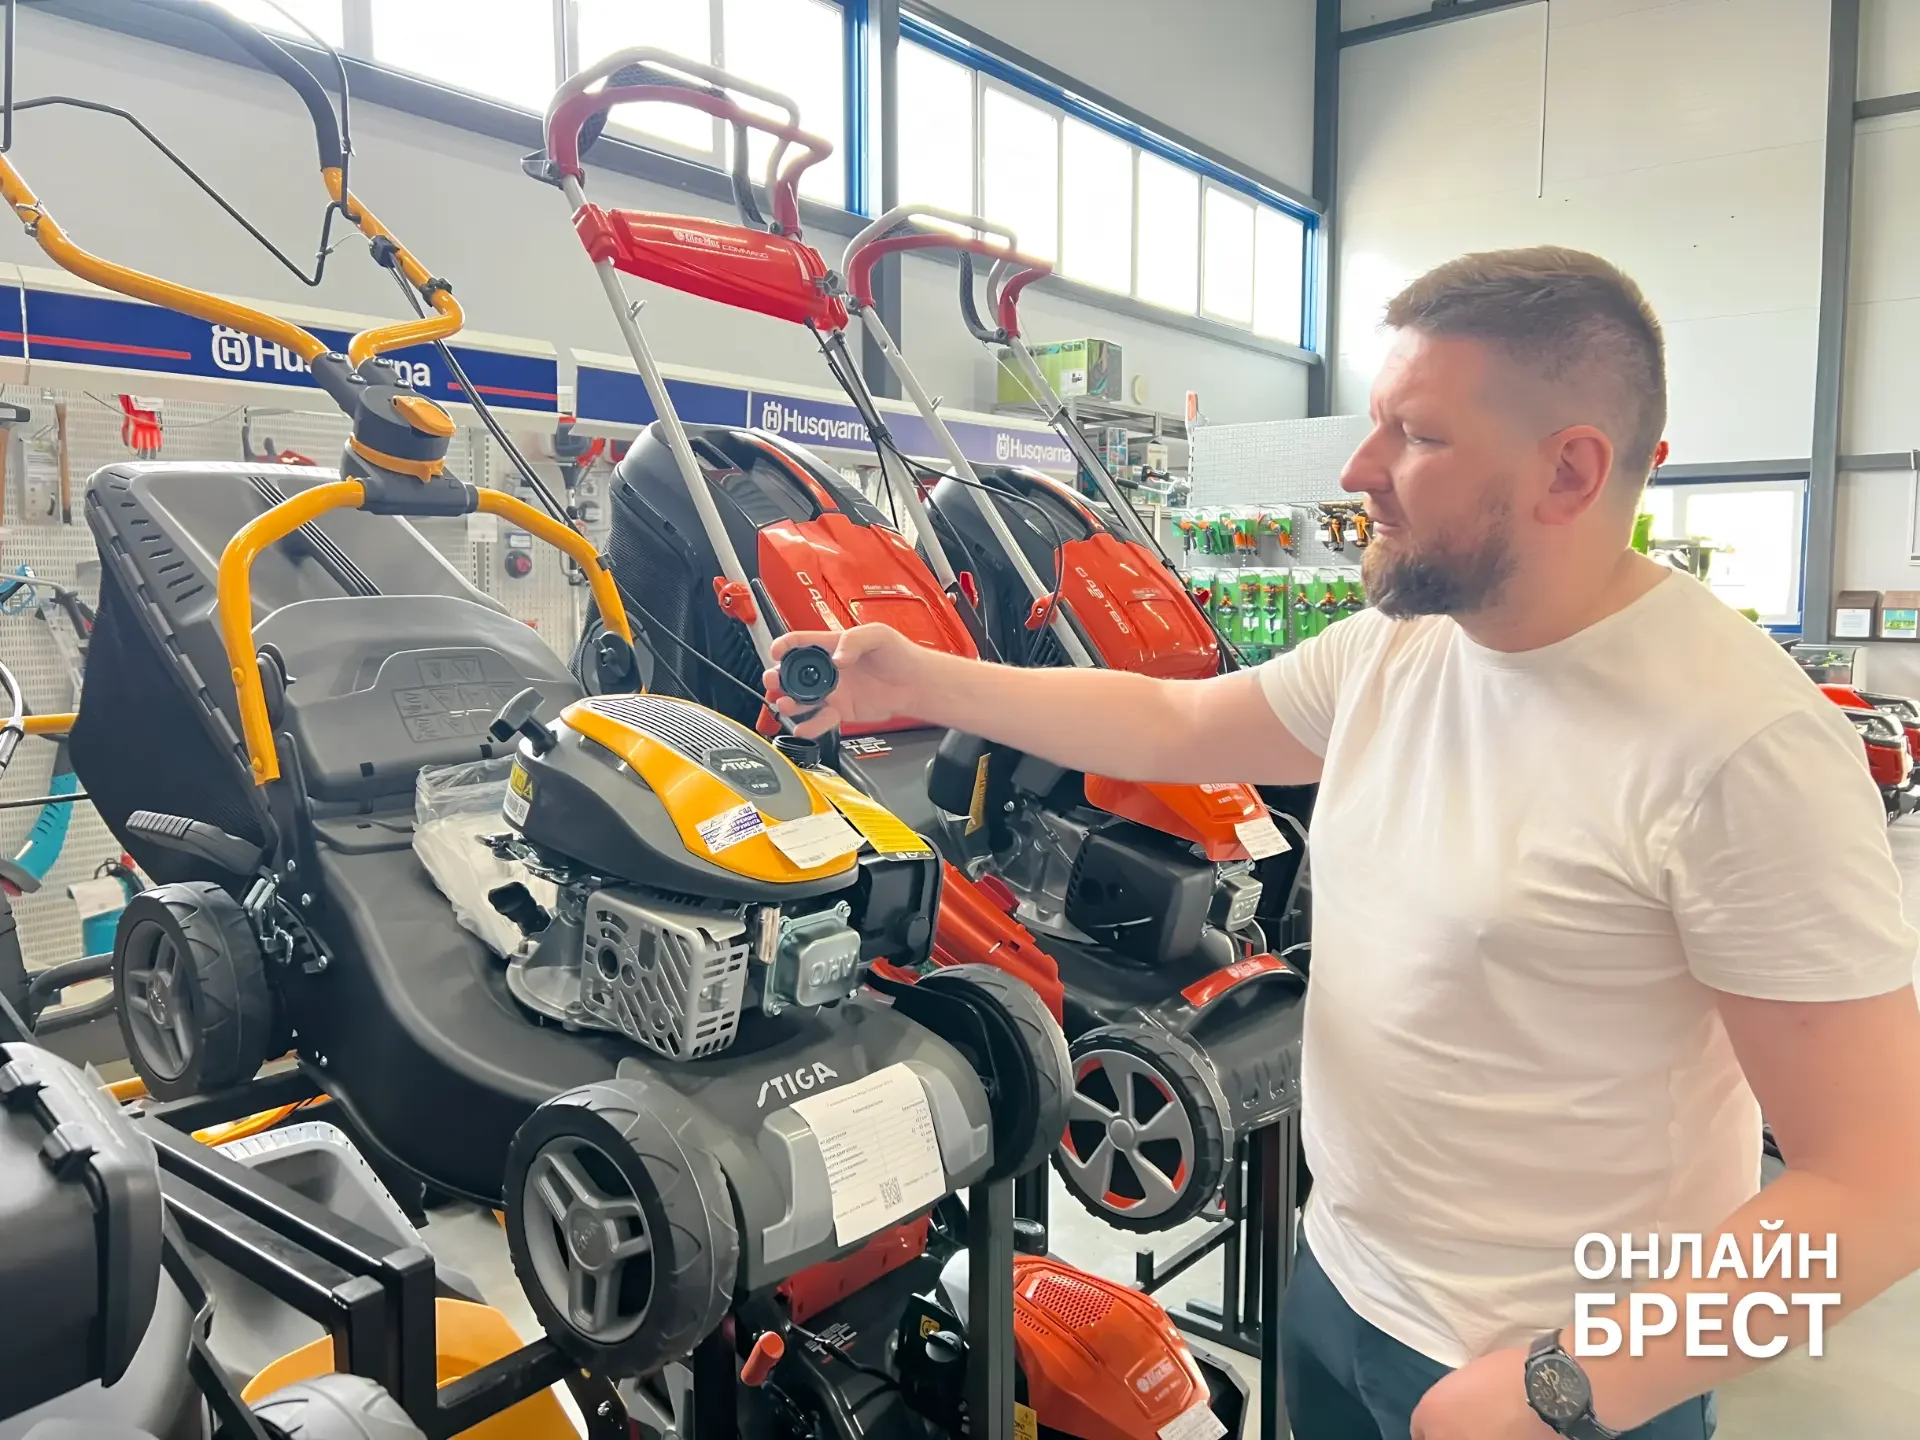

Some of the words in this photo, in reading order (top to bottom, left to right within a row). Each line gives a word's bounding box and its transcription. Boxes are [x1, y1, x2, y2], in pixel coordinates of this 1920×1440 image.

[783, 408, 872, 441] Husqvarna
[1011, 437, 1072, 463] Husqvarna
[845, 741, 893, 755] TEC
[721, 760, 765, 772] STIGA
[808, 950, 857, 987] OHV
[756, 1061, 839, 1108] STIGA
